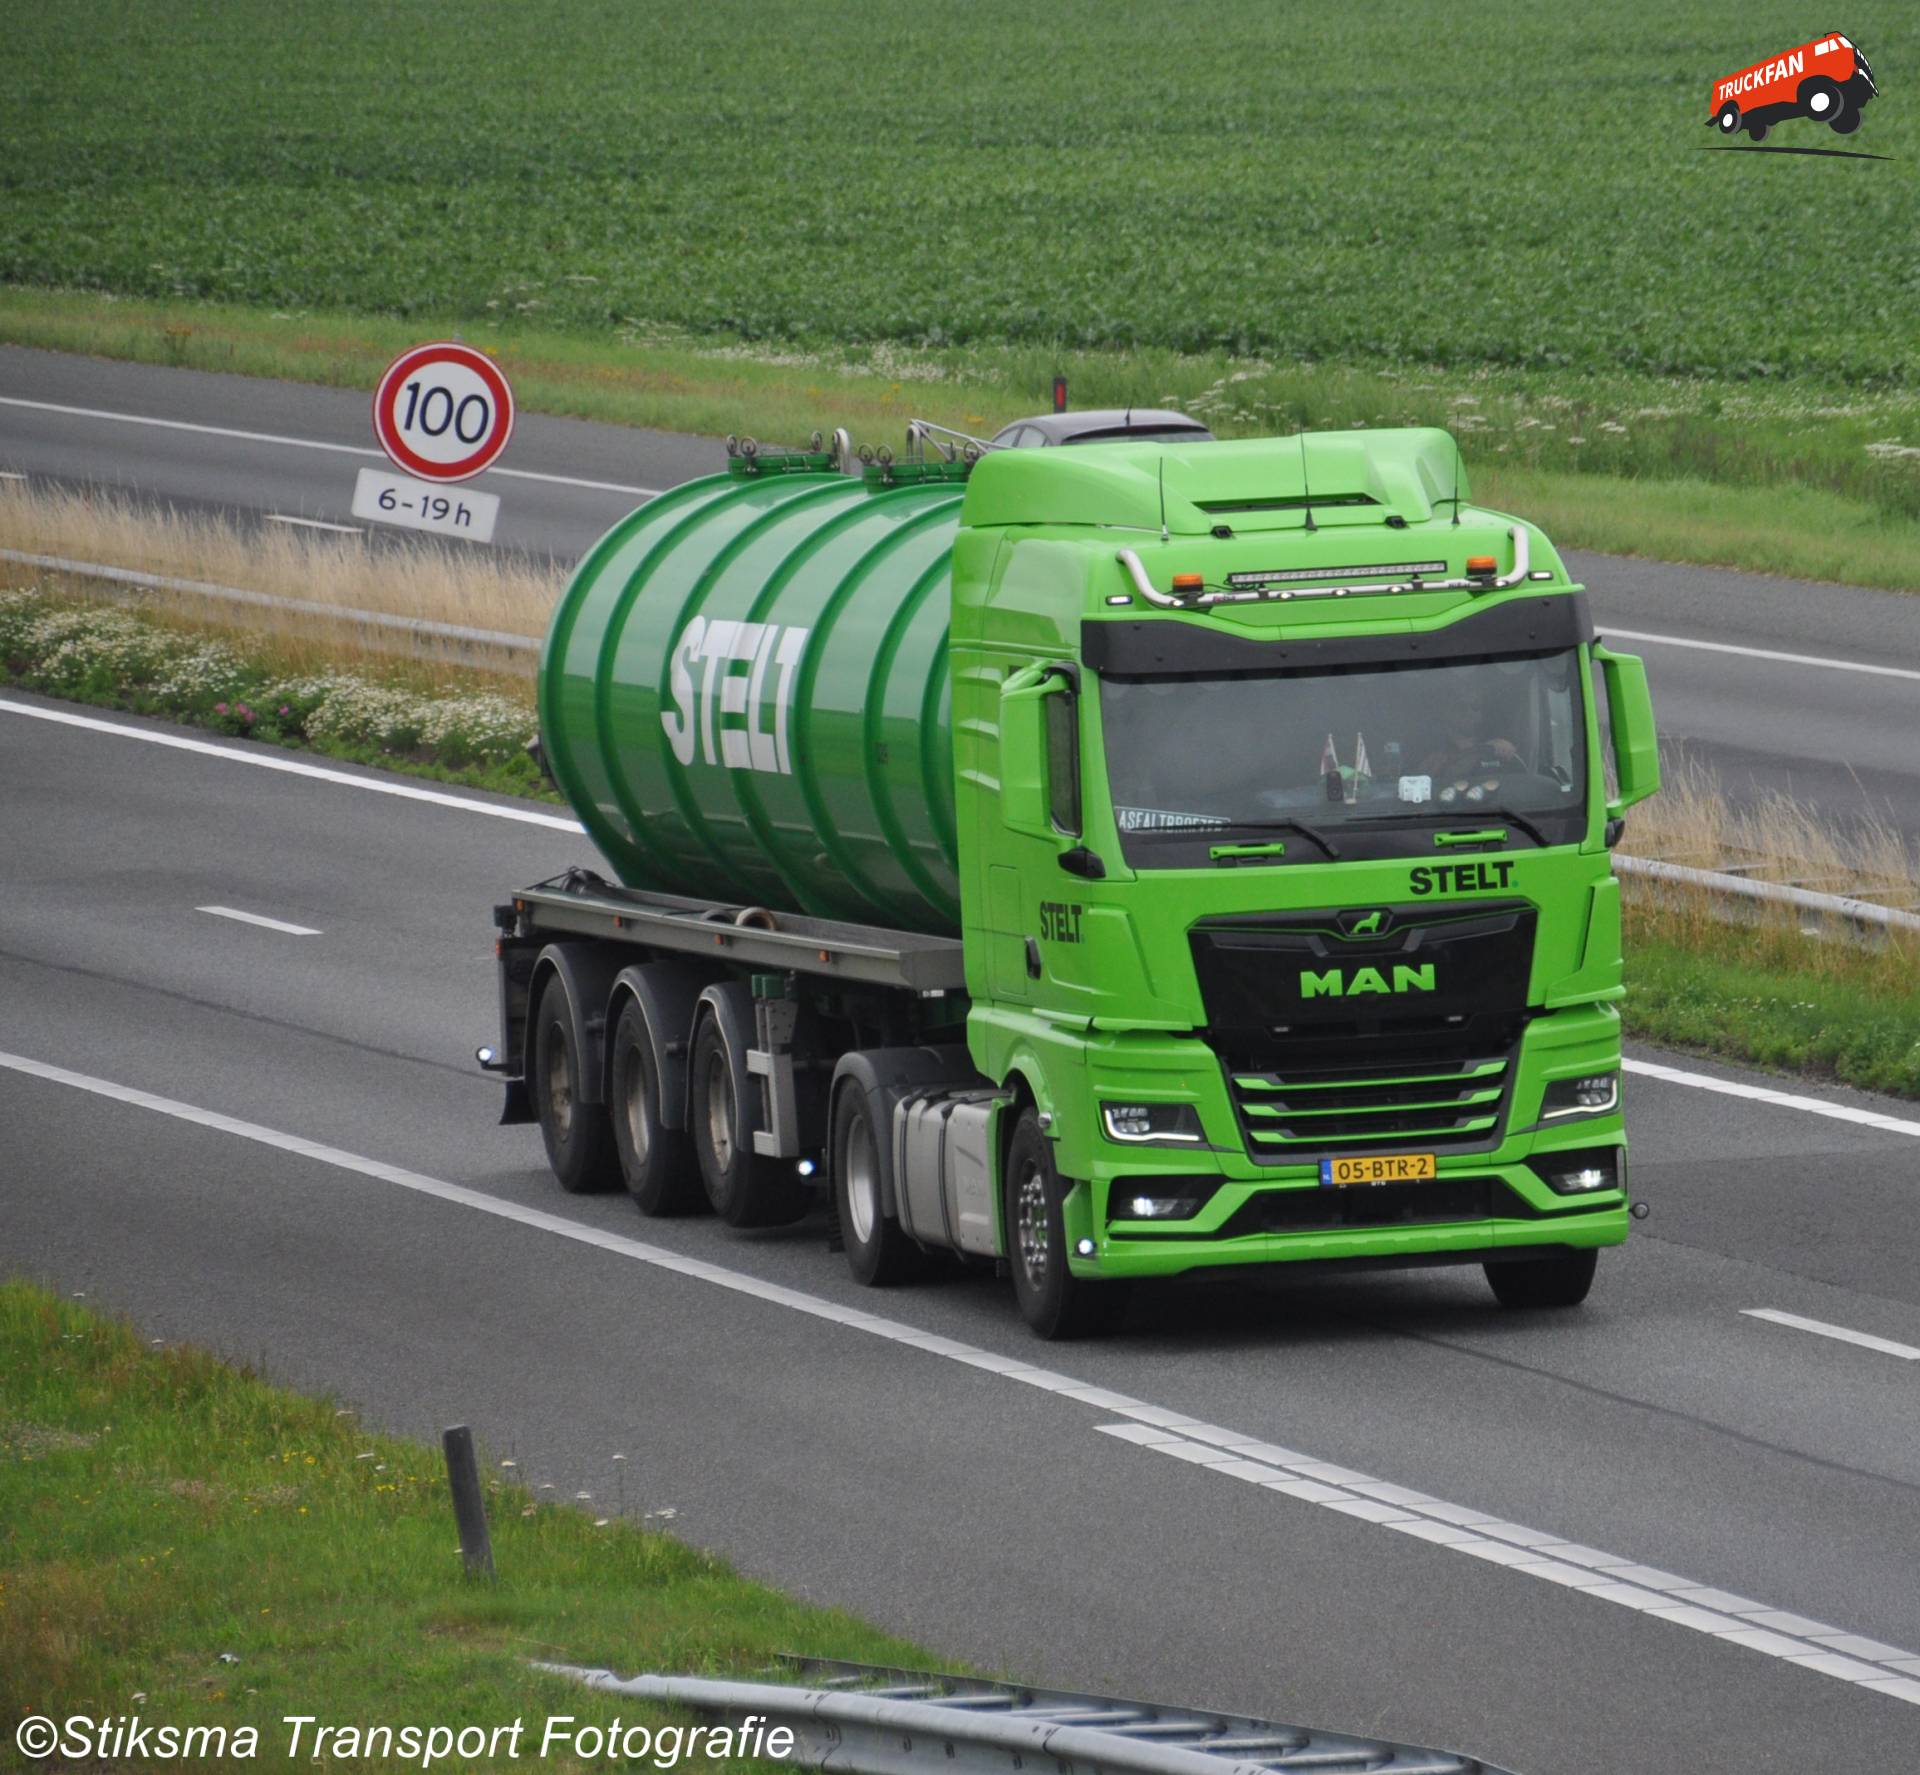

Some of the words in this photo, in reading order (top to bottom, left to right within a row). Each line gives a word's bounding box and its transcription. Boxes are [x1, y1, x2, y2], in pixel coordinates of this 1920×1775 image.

[404, 381, 489, 444] 100
[660, 615, 809, 775] STELT
[1300, 963, 1435, 998] MAN
[1338, 1157, 1428, 1180] 05-BTR-2
